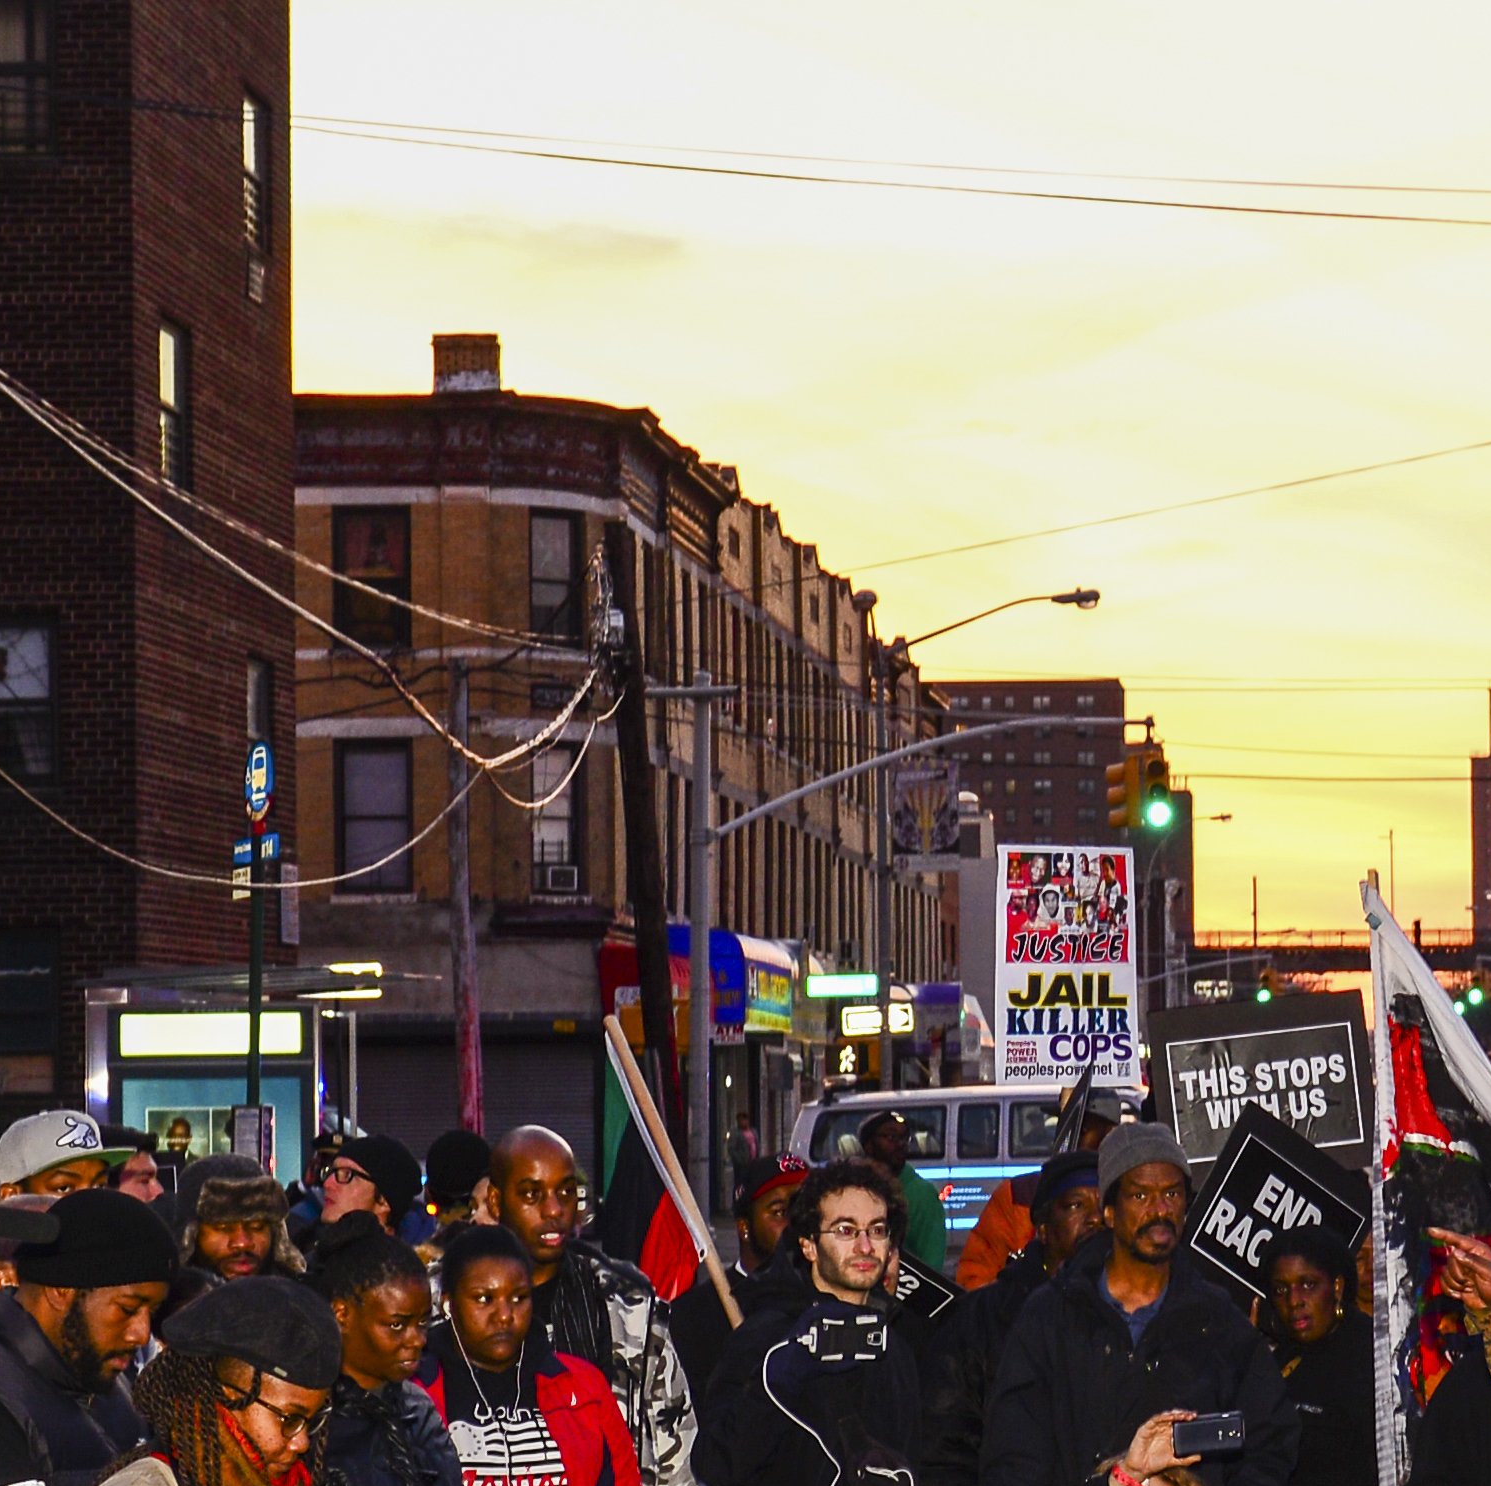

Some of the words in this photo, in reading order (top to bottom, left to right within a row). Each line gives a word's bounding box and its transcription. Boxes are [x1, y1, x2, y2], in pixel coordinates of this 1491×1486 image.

[1012, 931, 1125, 964] JUSTICE
[1008, 972, 1128, 1007] JAIL
[716, 1024, 743, 1035] ATM
[1006, 1008, 1131, 1035] KILLER
[1049, 1034, 1133, 1063] COPS
[1179, 1065, 1247, 1101] THIS
[1255, 1054, 1347, 1092] STOPS
[1288, 1088, 1328, 1120] US
